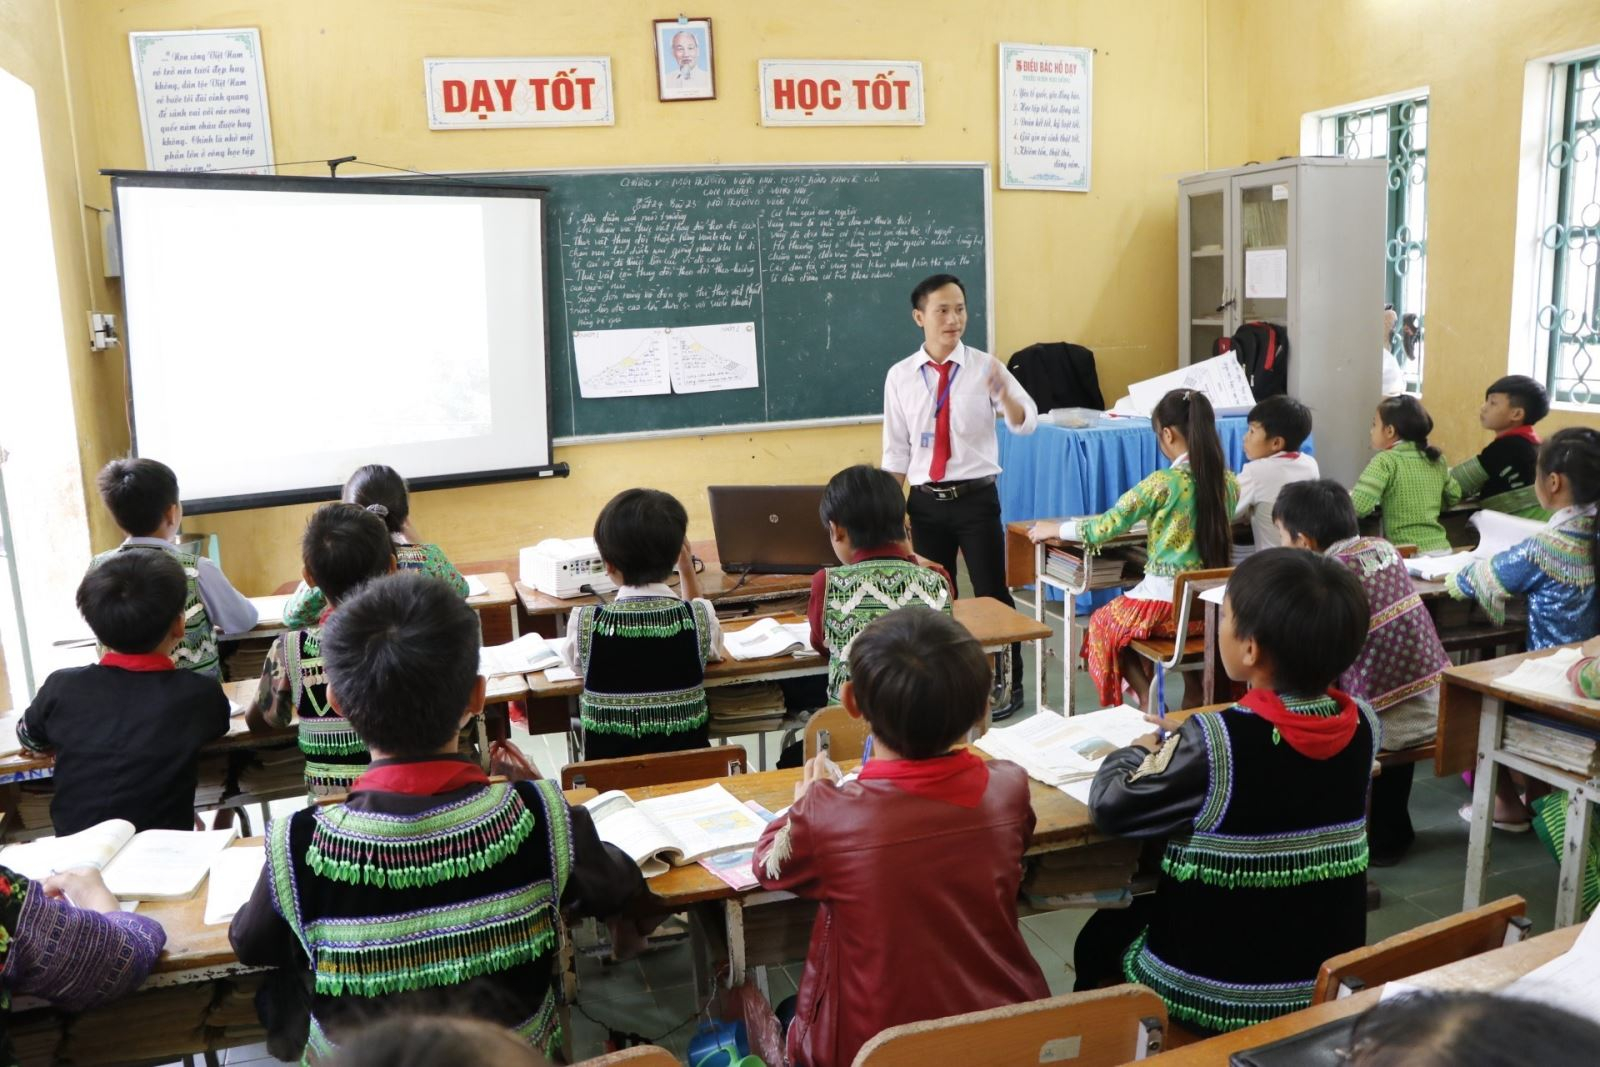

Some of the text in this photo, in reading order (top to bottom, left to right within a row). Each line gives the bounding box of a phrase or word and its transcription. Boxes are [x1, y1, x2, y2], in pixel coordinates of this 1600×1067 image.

[1040, 60, 1052, 73] BÁC
[442, 68, 596, 120] DẠY TỐT
[773, 70, 911, 116] HỌC TỐT
